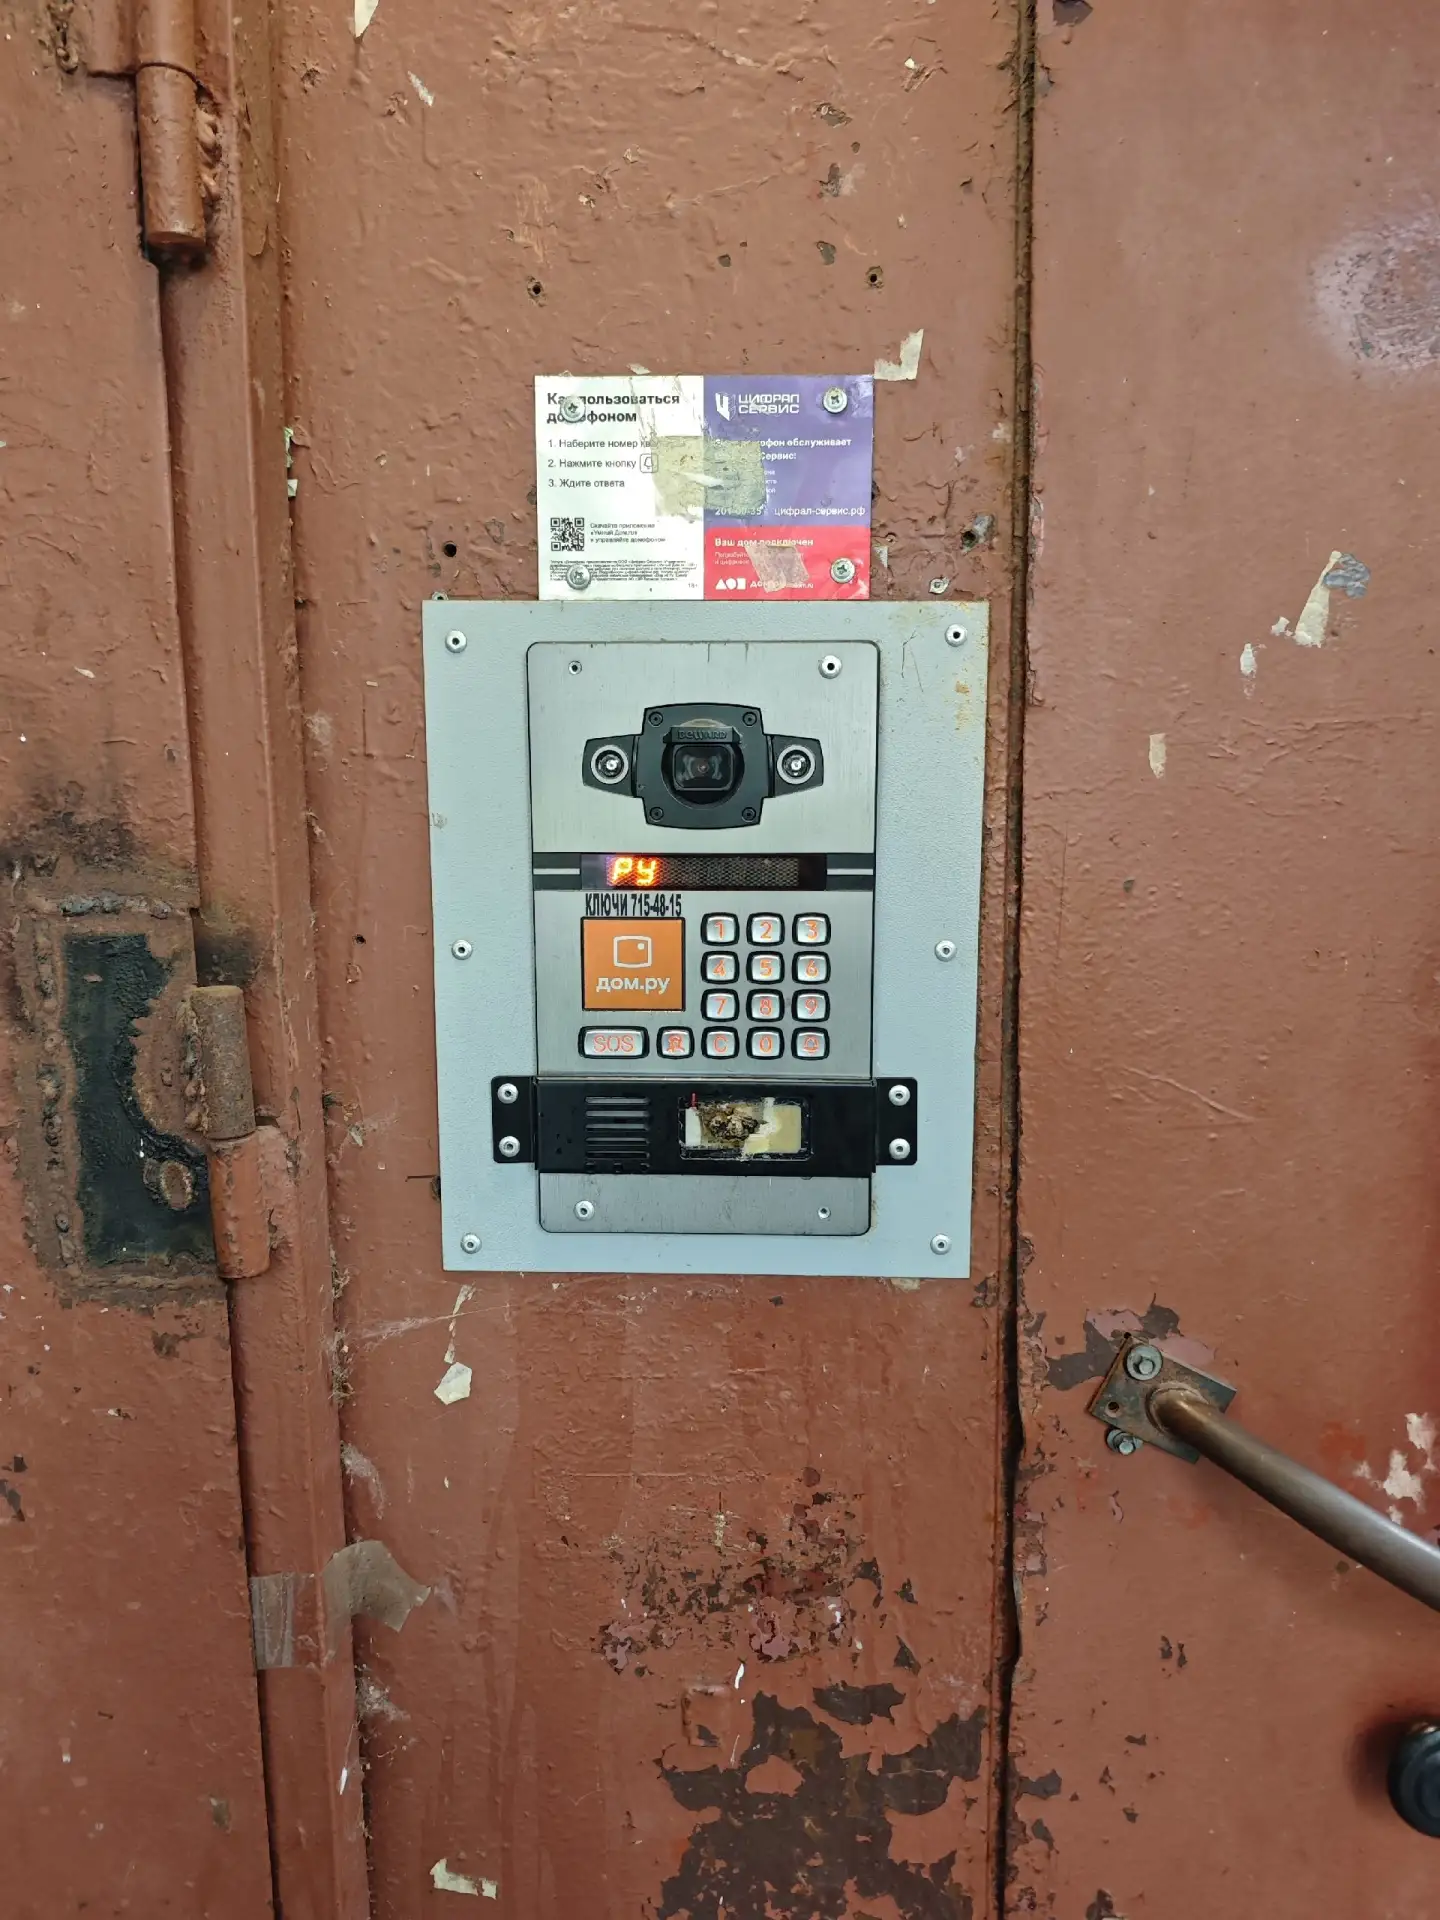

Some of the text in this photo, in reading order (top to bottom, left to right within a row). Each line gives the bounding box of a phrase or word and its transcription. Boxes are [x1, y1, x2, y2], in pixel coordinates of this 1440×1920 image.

[738, 394, 800, 404] ЦИФРАЛ
[738, 404, 800, 414] СЕРВИС
[548, 440, 557, 448] 1.
[559, 440, 605, 449] Наберите
[787, 437, 852, 449] обслуживает
[548, 459, 637, 469] 2. Нажмите кнопку
[548, 479, 557, 487] 3.
[560, 479, 592, 488] Ждите
[774, 506, 866, 517] цифрал-сервис.рф
[714, 538, 735, 547] Ваш
[585, 893, 682, 917] КЛЮЧИ 715-48-15
[714, 920, 818, 939] 1 2 3
[712, 959, 818, 977] 4 5 6
[596, 977, 671, 995] дом.ру
[714, 997, 818, 1016] 7 8 9
[593, 1034, 635, 1053] SOS
